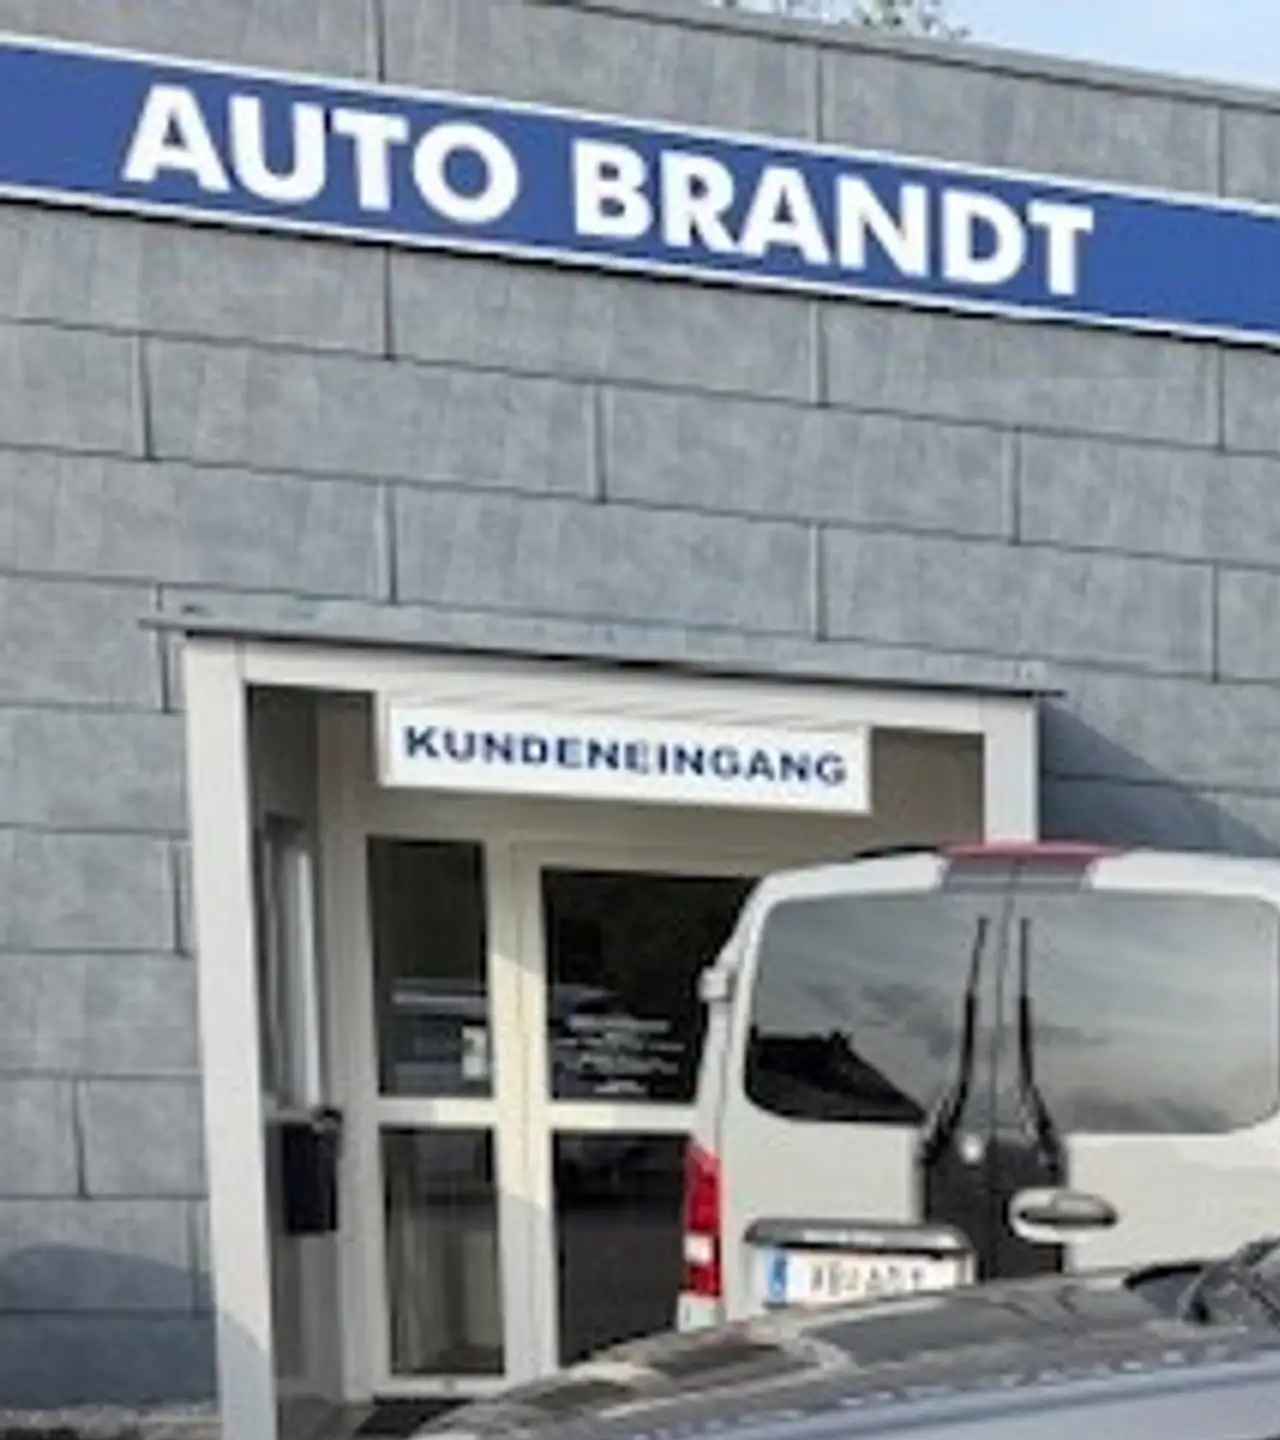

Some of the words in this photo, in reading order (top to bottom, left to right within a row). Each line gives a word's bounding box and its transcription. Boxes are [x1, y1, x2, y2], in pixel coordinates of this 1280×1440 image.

[123, 85, 519, 223] AUTO
[572, 139, 1095, 296] BRANDT
[404, 725, 848, 784] KUNDENEINGANG
